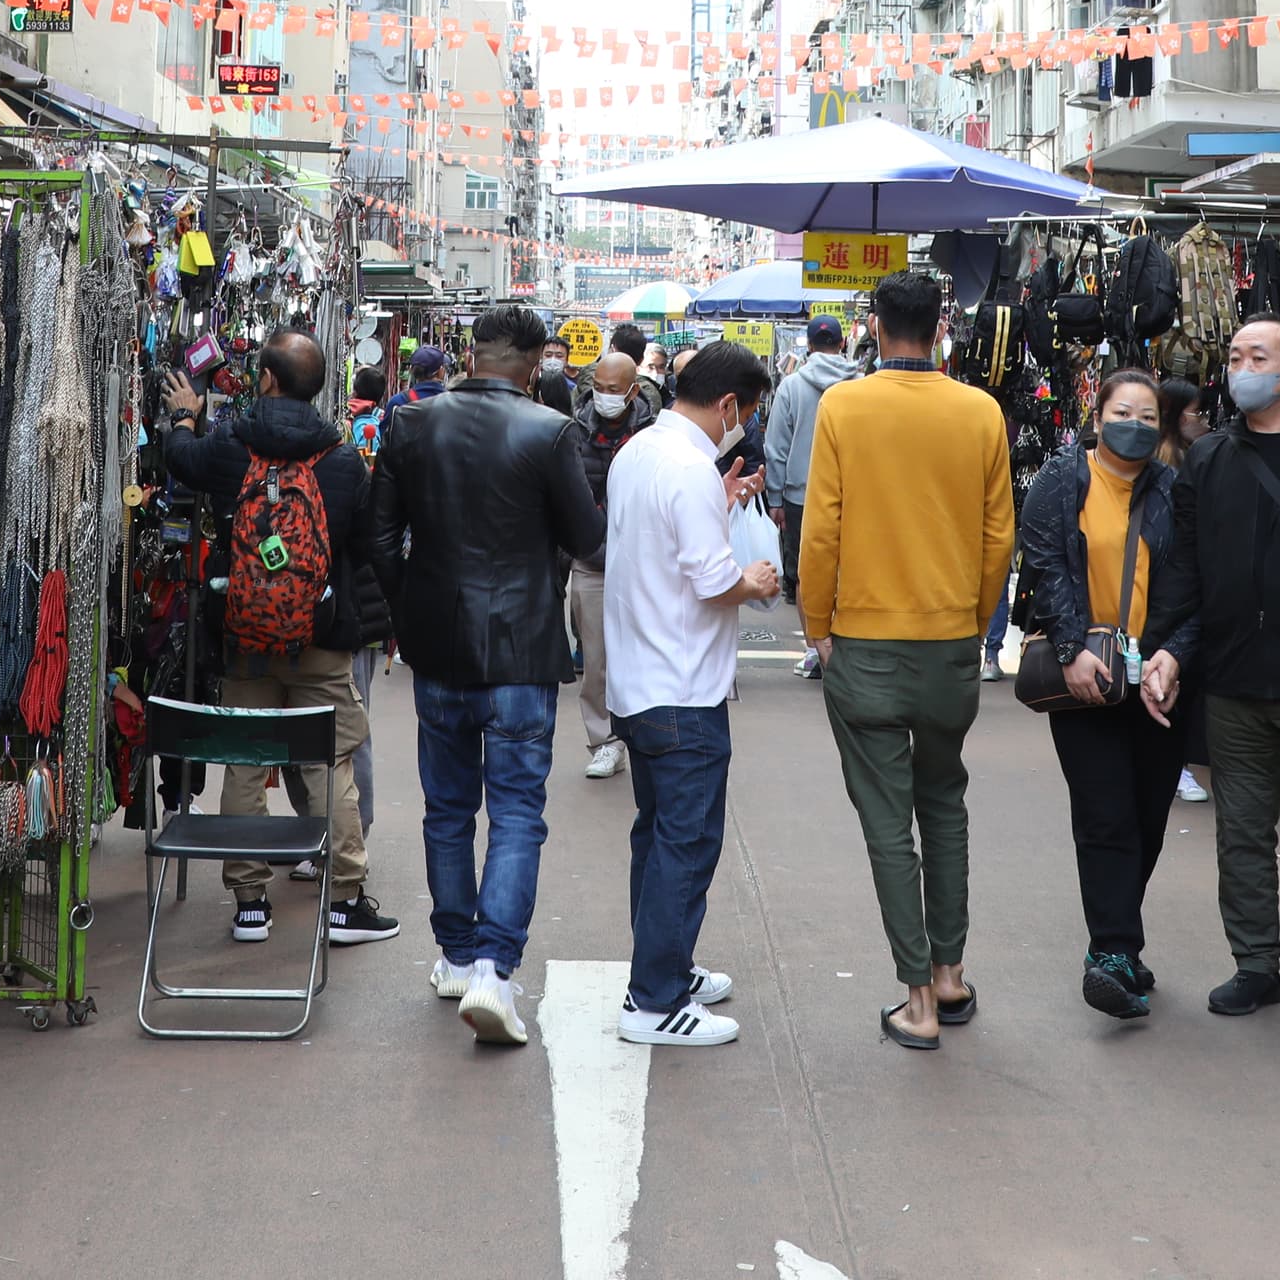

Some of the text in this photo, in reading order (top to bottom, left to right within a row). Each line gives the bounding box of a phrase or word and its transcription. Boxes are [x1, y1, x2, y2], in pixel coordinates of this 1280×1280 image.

[26, 22, 48, 31] 5939
[822, 241, 890, 271] 蓮明
[577, 344, 600, 352] CARD
[239, 910, 266, 922] PUMA
